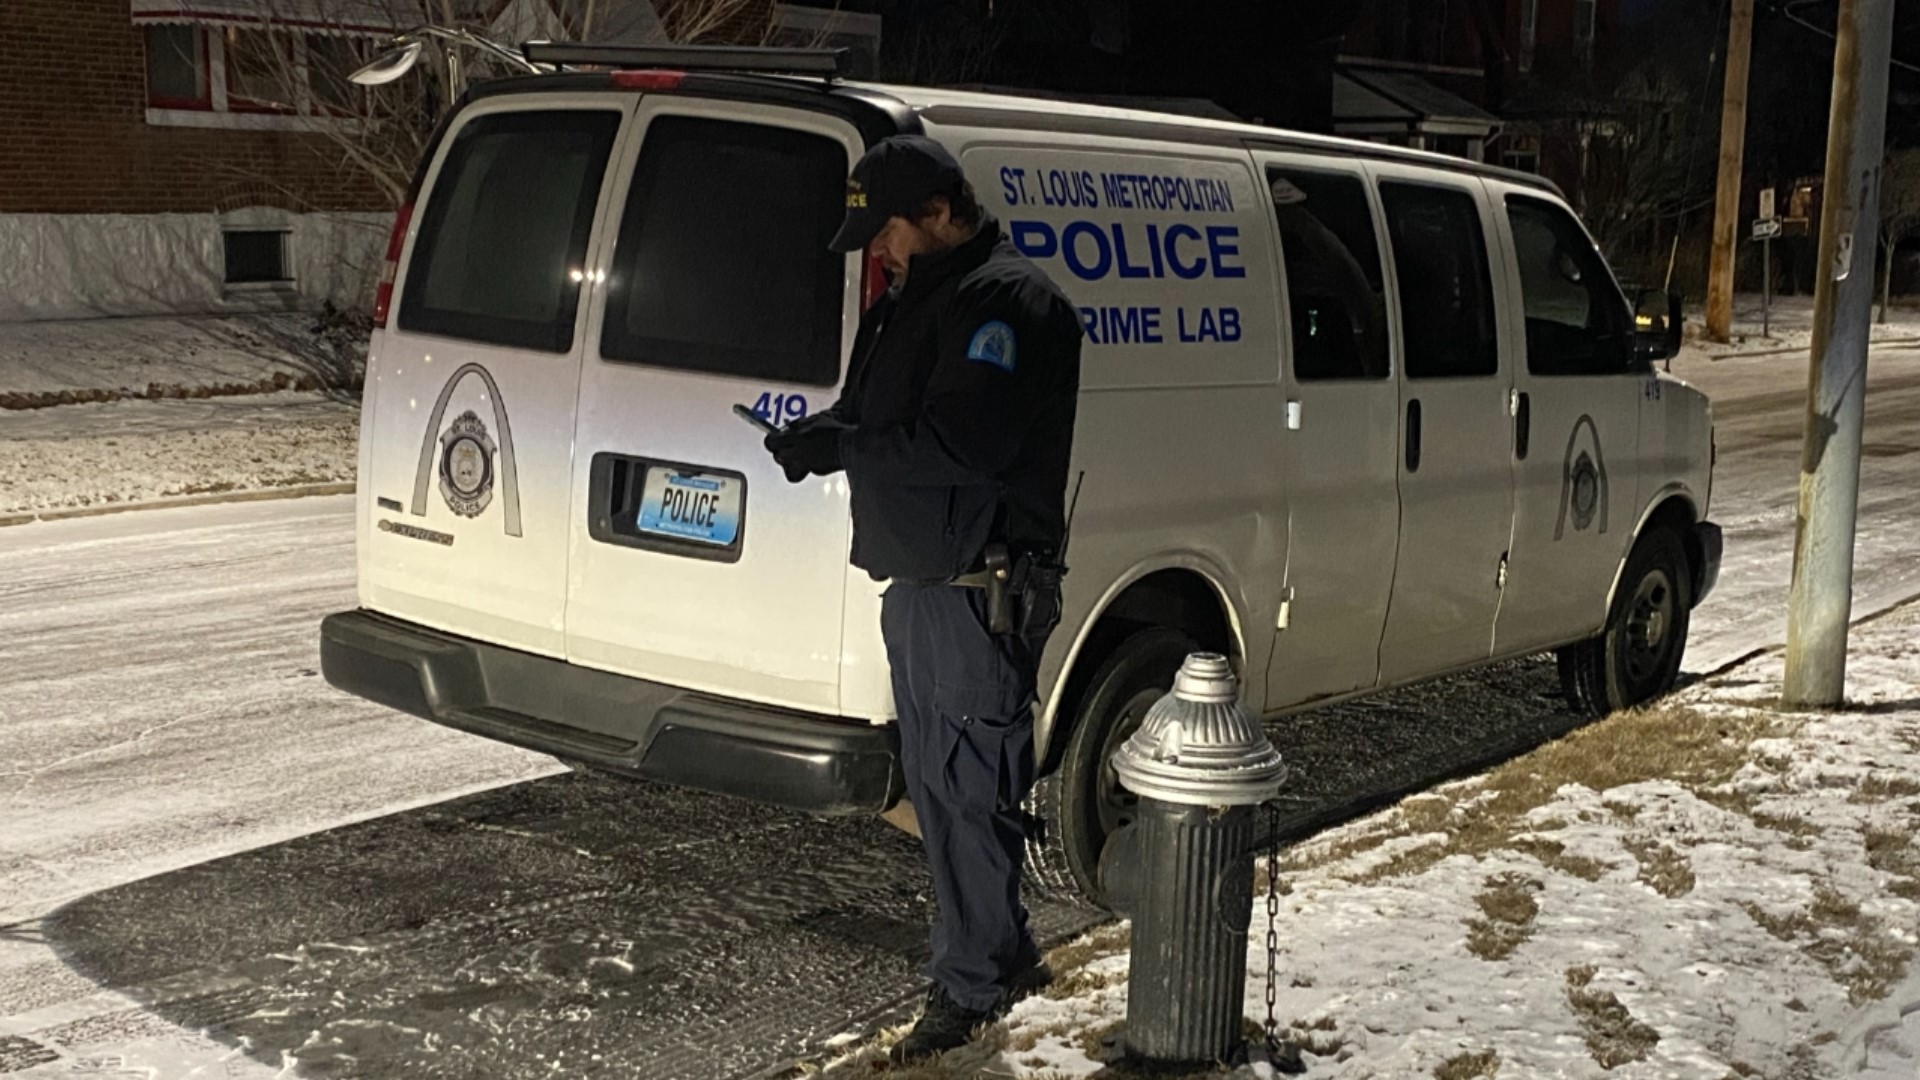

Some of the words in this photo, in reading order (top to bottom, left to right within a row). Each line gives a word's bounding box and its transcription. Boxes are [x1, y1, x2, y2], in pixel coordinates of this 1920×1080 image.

[1000, 166, 1035, 206] ST.
[1037, 169, 1098, 209] LOUIS
[1100, 173, 1234, 213] METROPOLITAN
[1010, 220, 1246, 281] POLICE
[1080, 307, 1163, 344] RIME
[1177, 307, 1241, 343] LAB
[751, 392, 807, 426] 419
[450, 496, 480, 512] POLICE
[659, 488, 719, 527] POLICE
